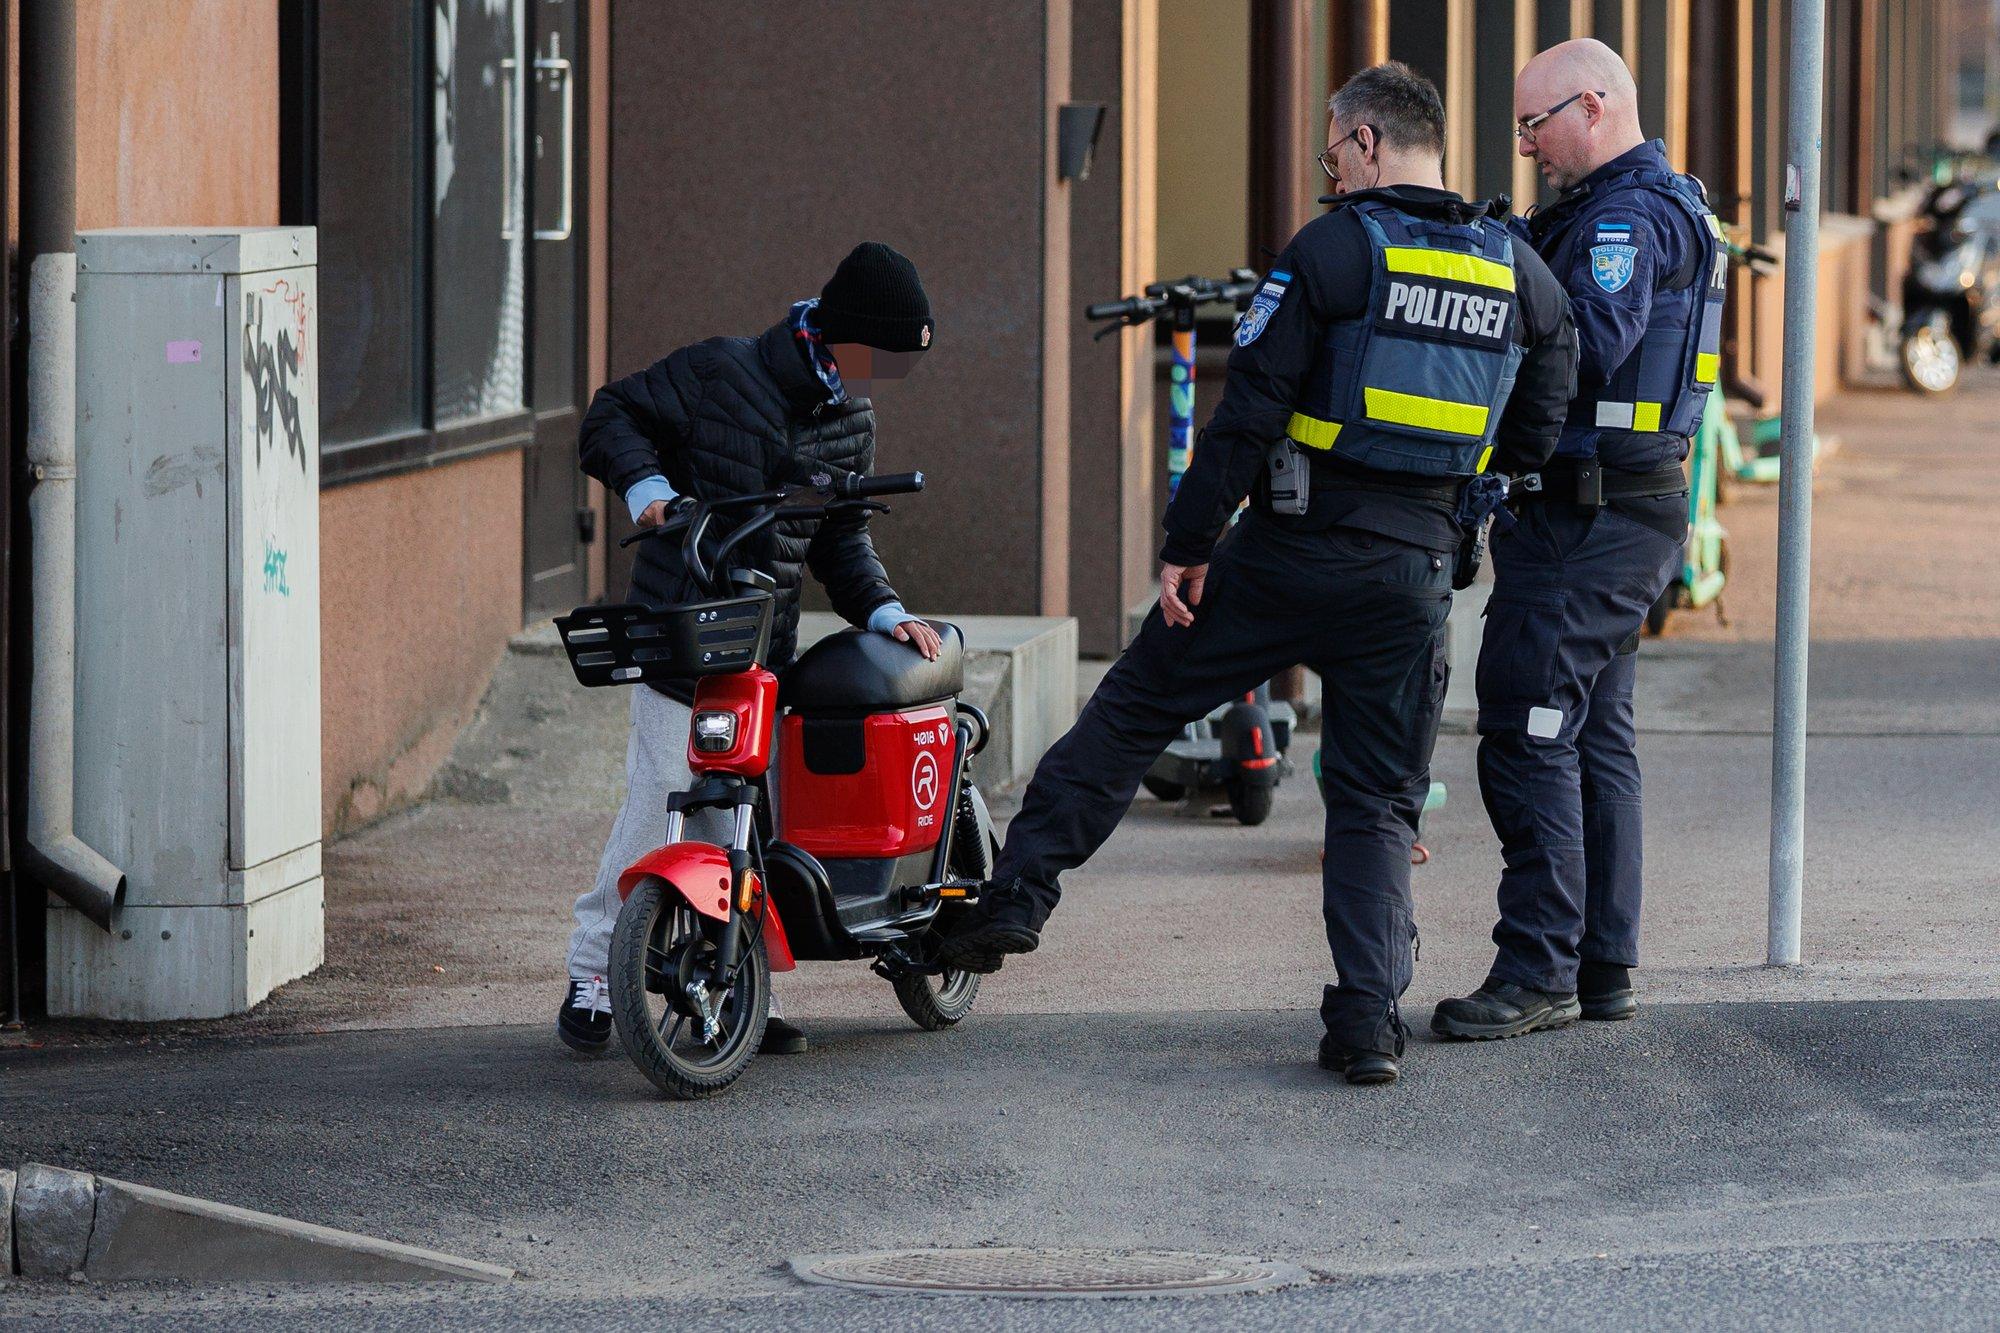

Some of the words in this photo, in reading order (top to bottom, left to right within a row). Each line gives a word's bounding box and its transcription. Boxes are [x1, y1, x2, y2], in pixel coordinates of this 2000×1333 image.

[1595, 246, 1632, 254] POLITSEI
[1385, 282, 1509, 339] POLITSEI
[913, 730, 935, 746] 4018
[917, 814, 934, 827] RIDE
